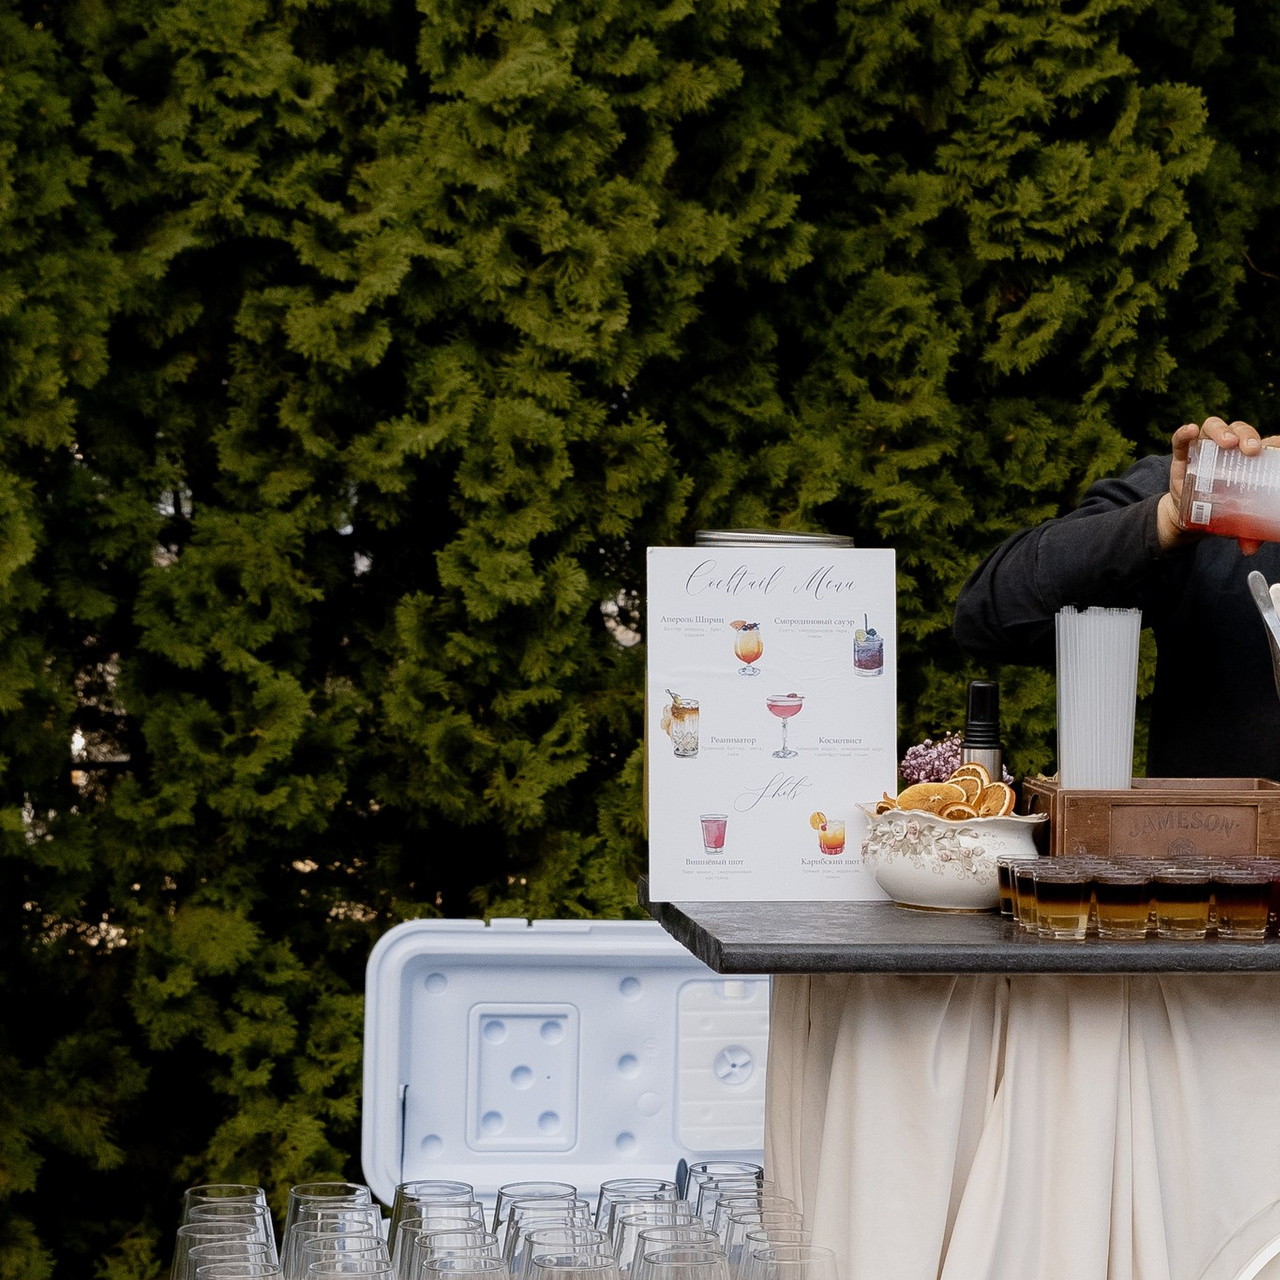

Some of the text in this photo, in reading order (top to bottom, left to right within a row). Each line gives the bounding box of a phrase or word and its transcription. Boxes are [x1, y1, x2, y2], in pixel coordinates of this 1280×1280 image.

[686, 559, 857, 600] Cocktail Menu
[660, 615, 725, 625] Апероль Шприц
[774, 617, 855, 627] Смородиновый сауэр
[711, 736, 757, 746] Реаниматор
[818, 736, 862, 744] Космотвист
[734, 772, 813, 812] Shots
[1128, 810, 1234, 838] JAMESON
[685, 858, 727, 866] Вишнёвый
[801, 858, 843, 867] Карибский
